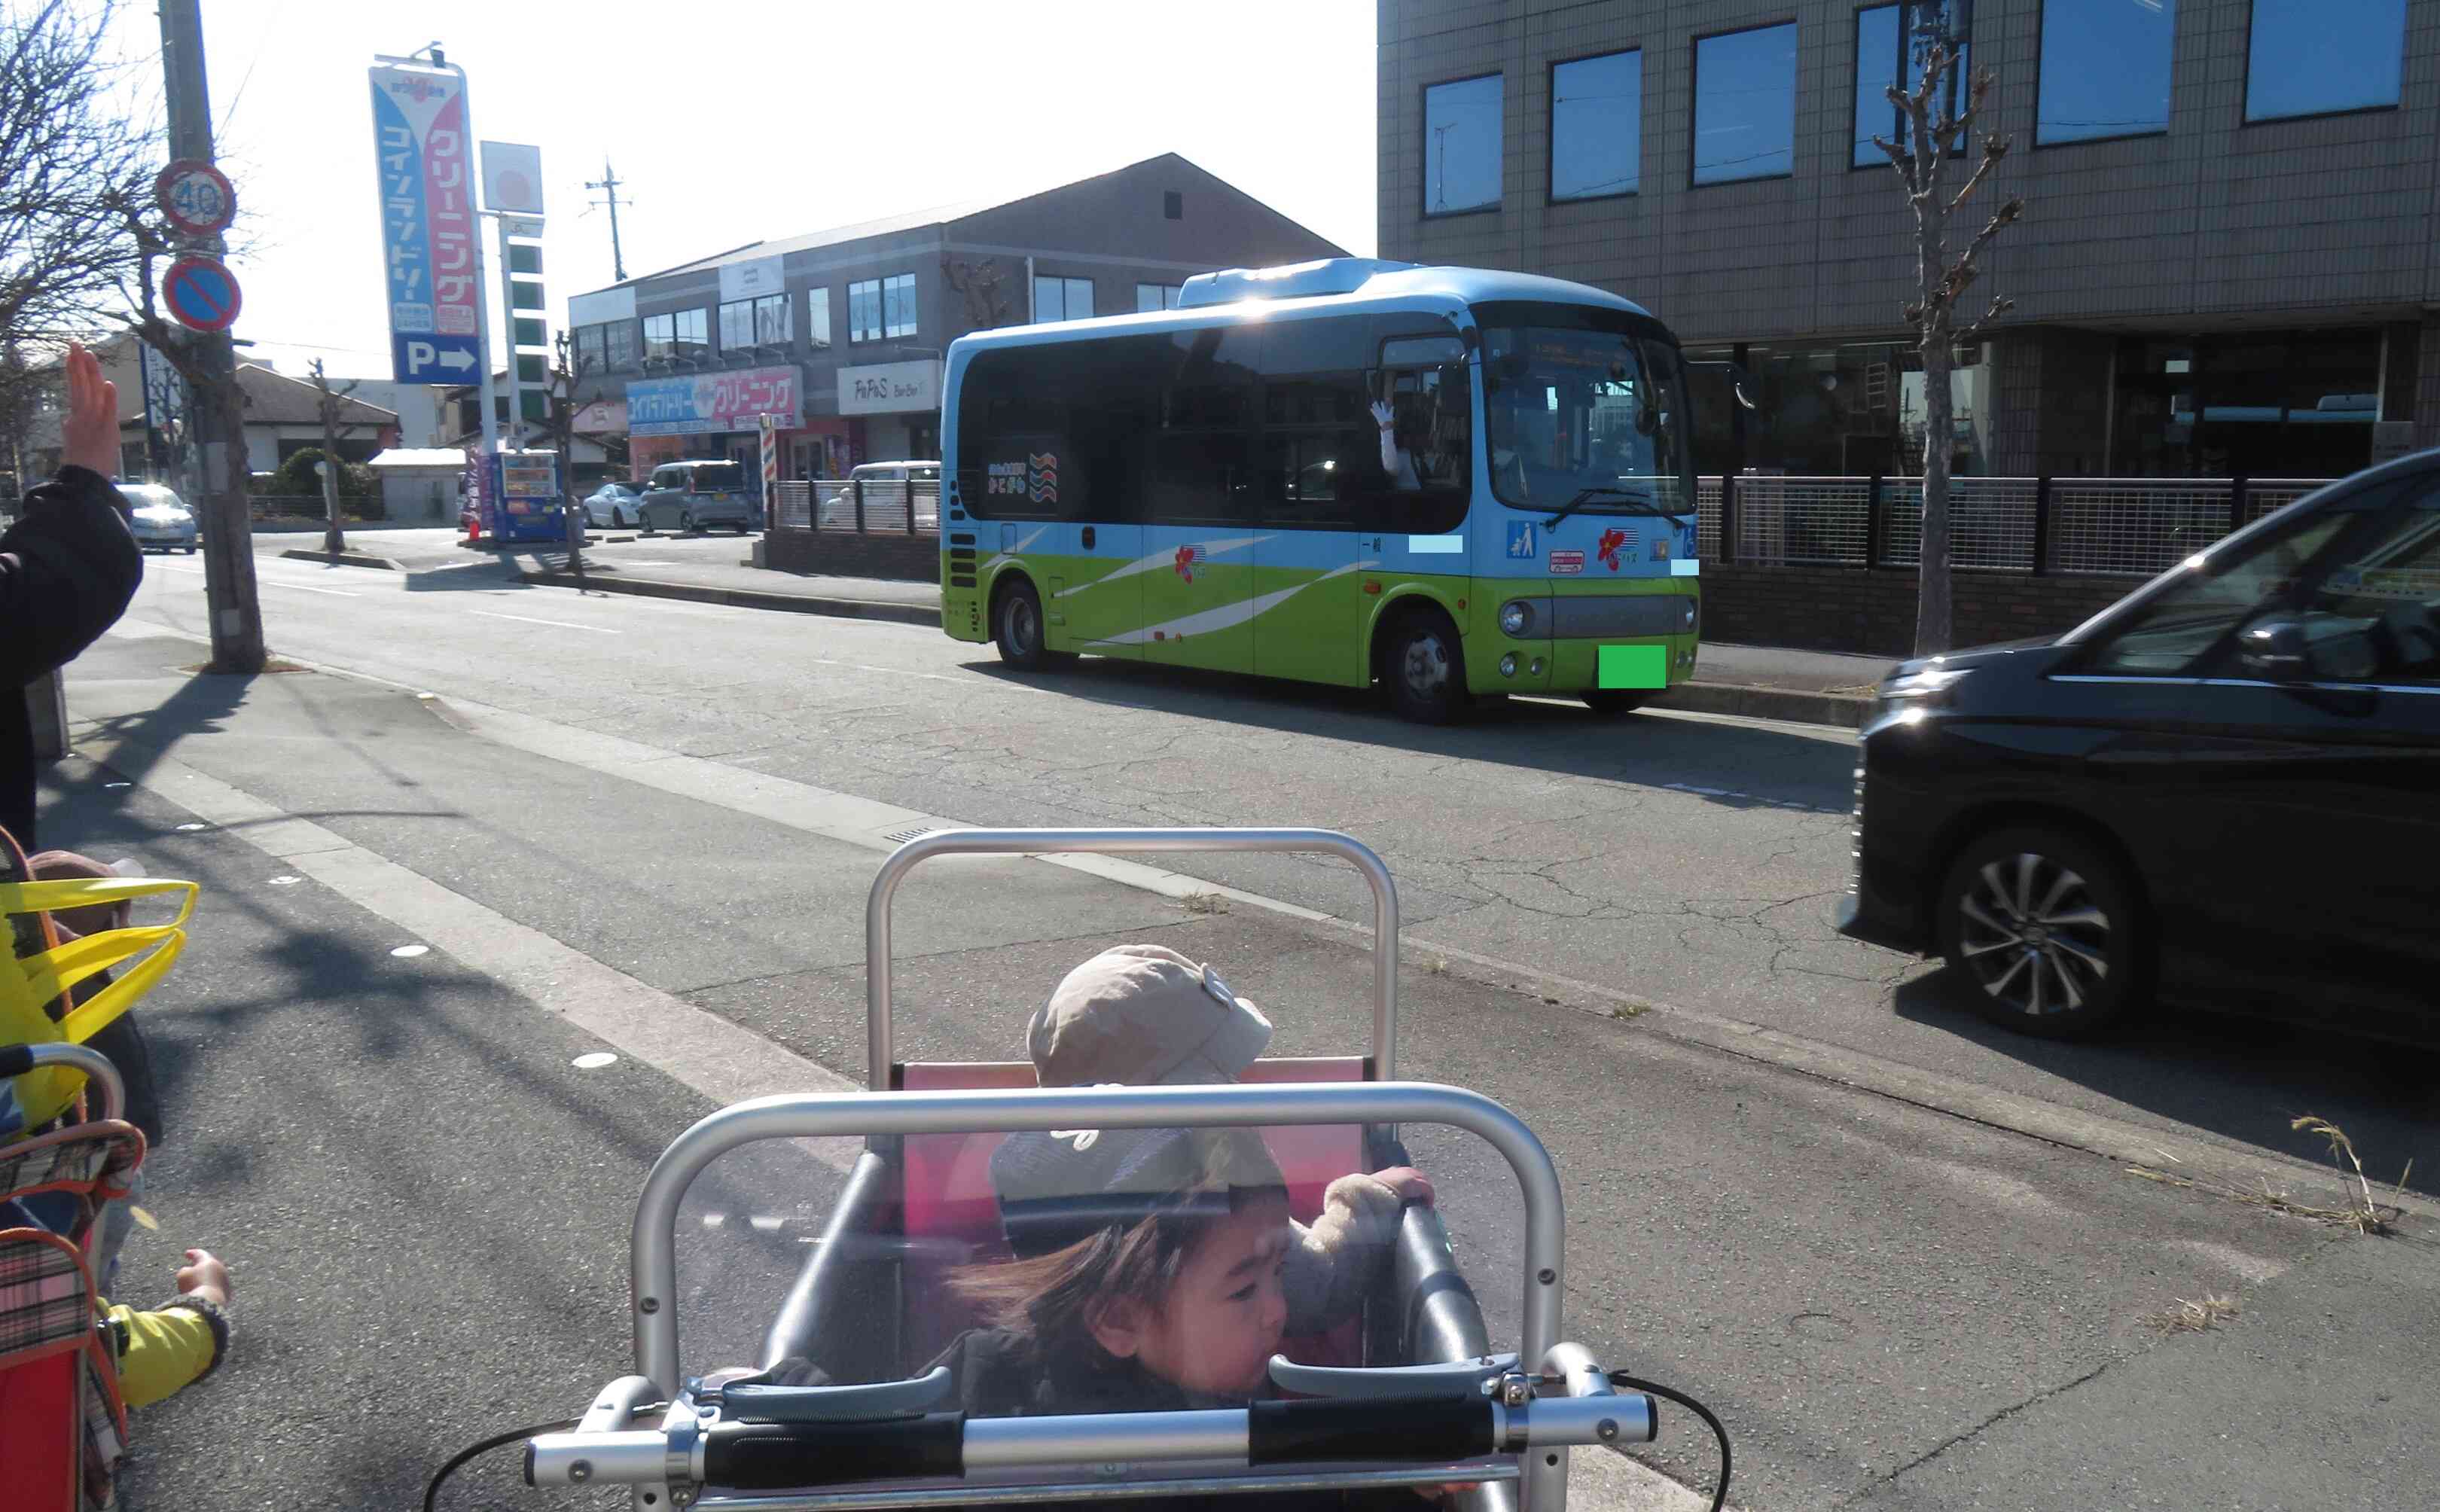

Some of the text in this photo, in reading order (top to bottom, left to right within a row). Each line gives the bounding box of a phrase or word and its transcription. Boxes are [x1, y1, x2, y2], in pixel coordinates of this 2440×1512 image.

[174, 180, 218, 216] 40
[383, 126, 422, 301] コインランドリー
[430, 129, 474, 302] クリーニング
[407, 341, 435, 374] P
[716, 377, 791, 413] クリーニング
